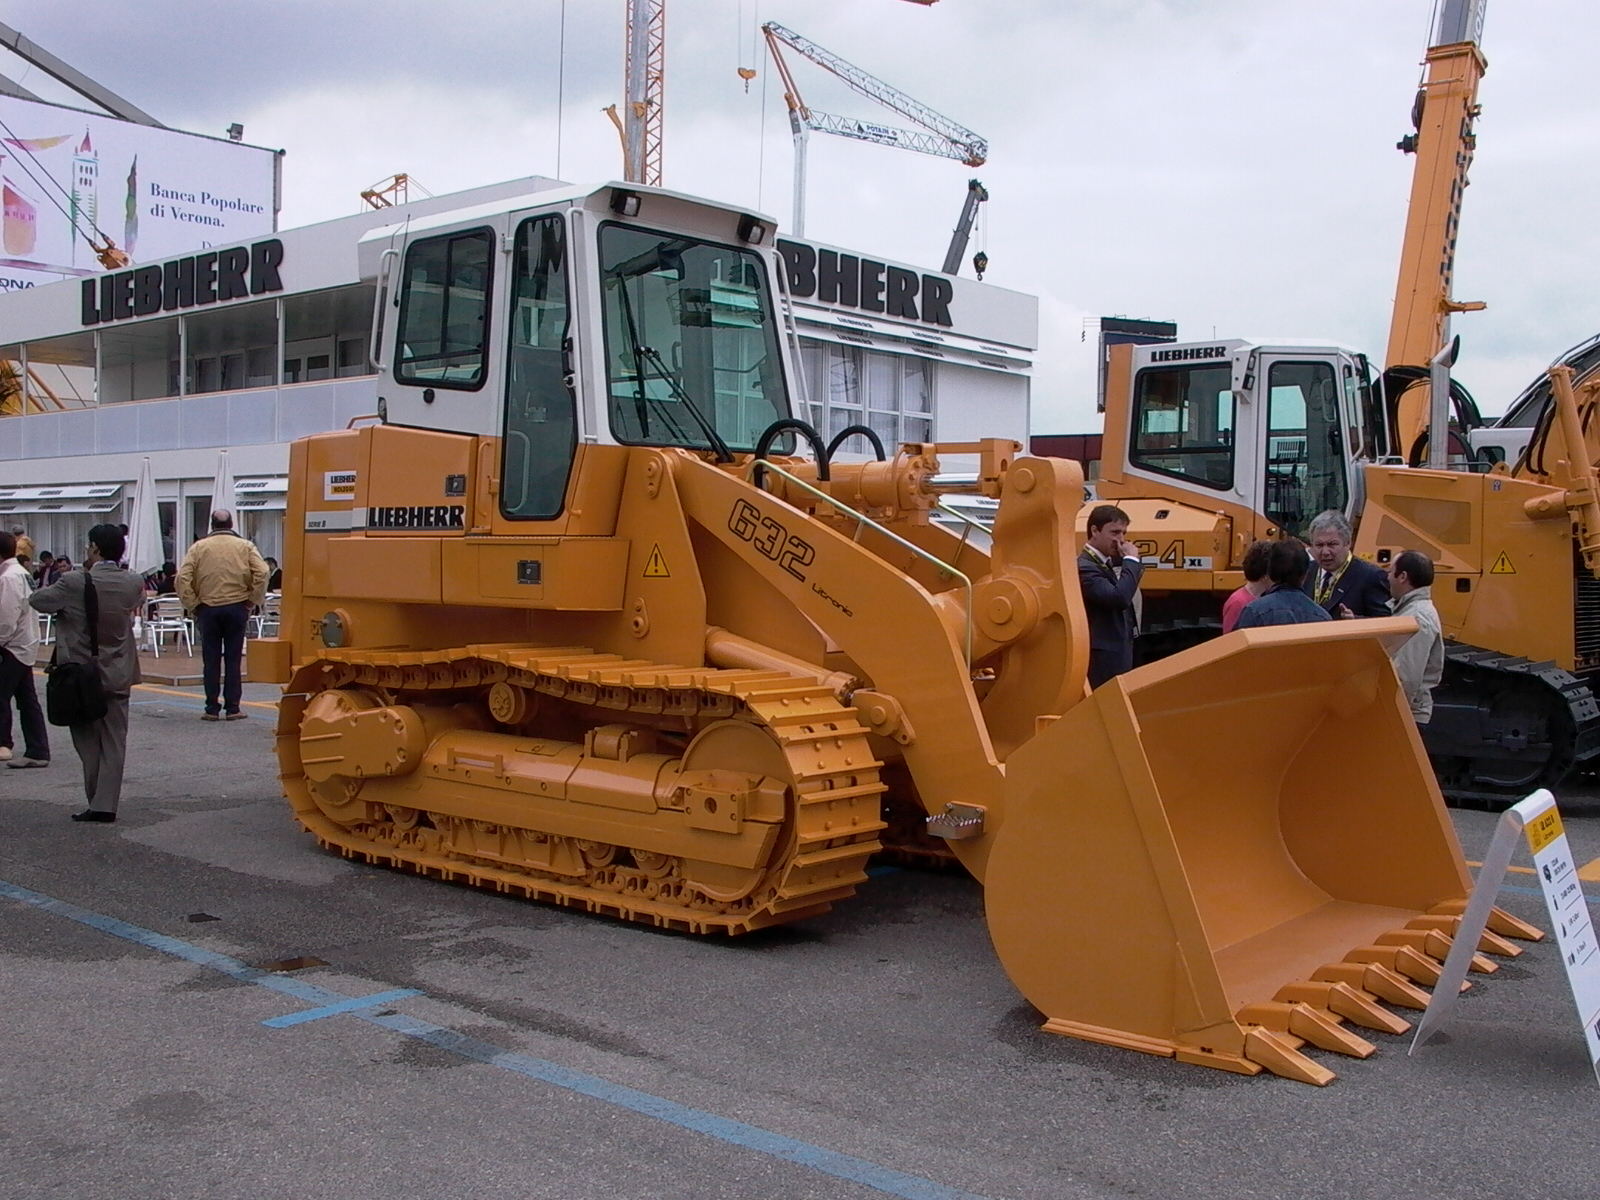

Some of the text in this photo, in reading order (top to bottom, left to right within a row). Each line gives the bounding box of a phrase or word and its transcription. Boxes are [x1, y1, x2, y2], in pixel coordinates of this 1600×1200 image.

[151, 182, 264, 214] Banca Popolare
[150, 204, 225, 227] di Verona.
[82, 238, 284, 325] LIEBHERR
[776, 238, 954, 326] BHERR
[1151, 346, 1227, 363] LIEBHERR
[330, 475, 356, 484] LIEBHER
[368, 505, 465, 528] LIEBHERR
[728, 498, 815, 583] 632
[1128, 539, 1203, 569] 24 XL
[811, 582, 854, 618] Litronic
